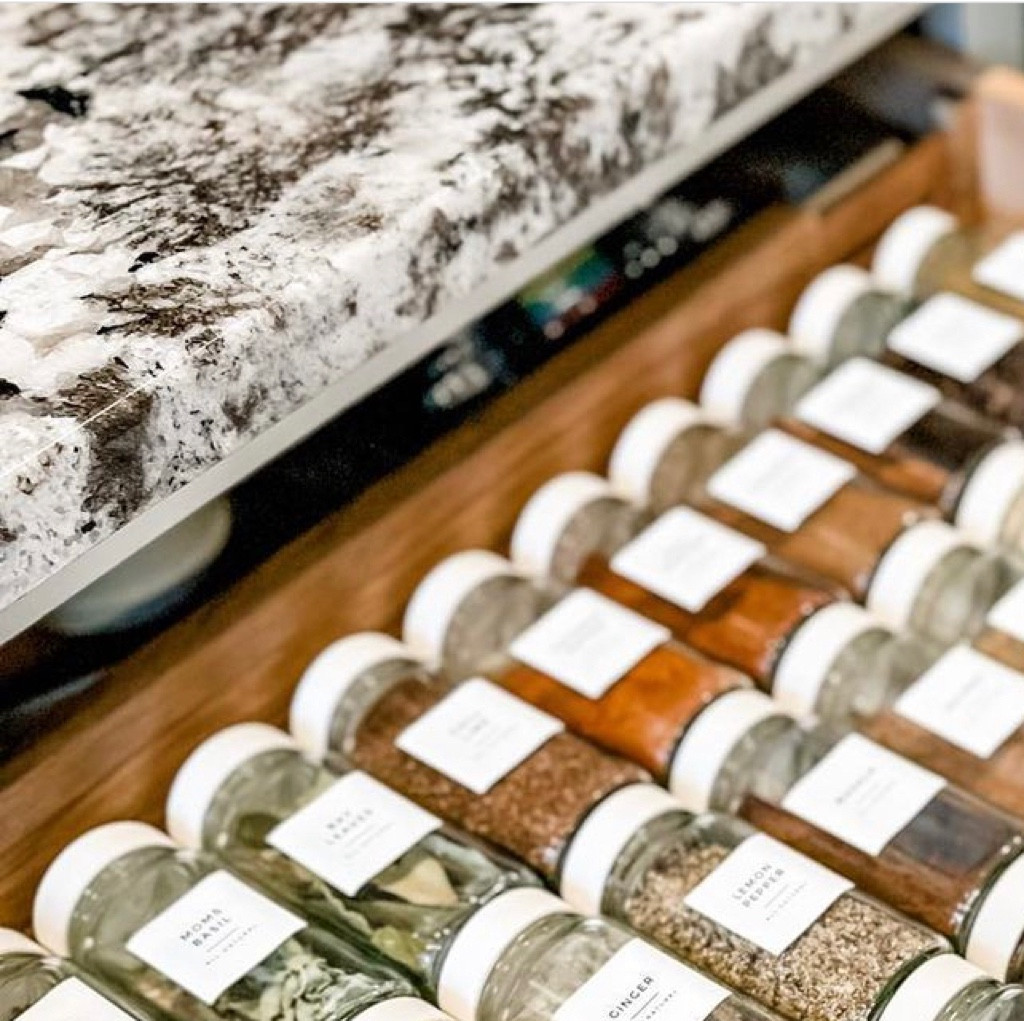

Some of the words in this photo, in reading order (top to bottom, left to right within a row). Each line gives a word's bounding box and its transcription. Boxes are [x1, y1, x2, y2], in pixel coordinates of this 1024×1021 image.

[731, 864, 773, 900] LEMON
[742, 867, 785, 908] PEPPER
[192, 917, 230, 947] BASIL
[608, 975, 655, 1019] GINGER
